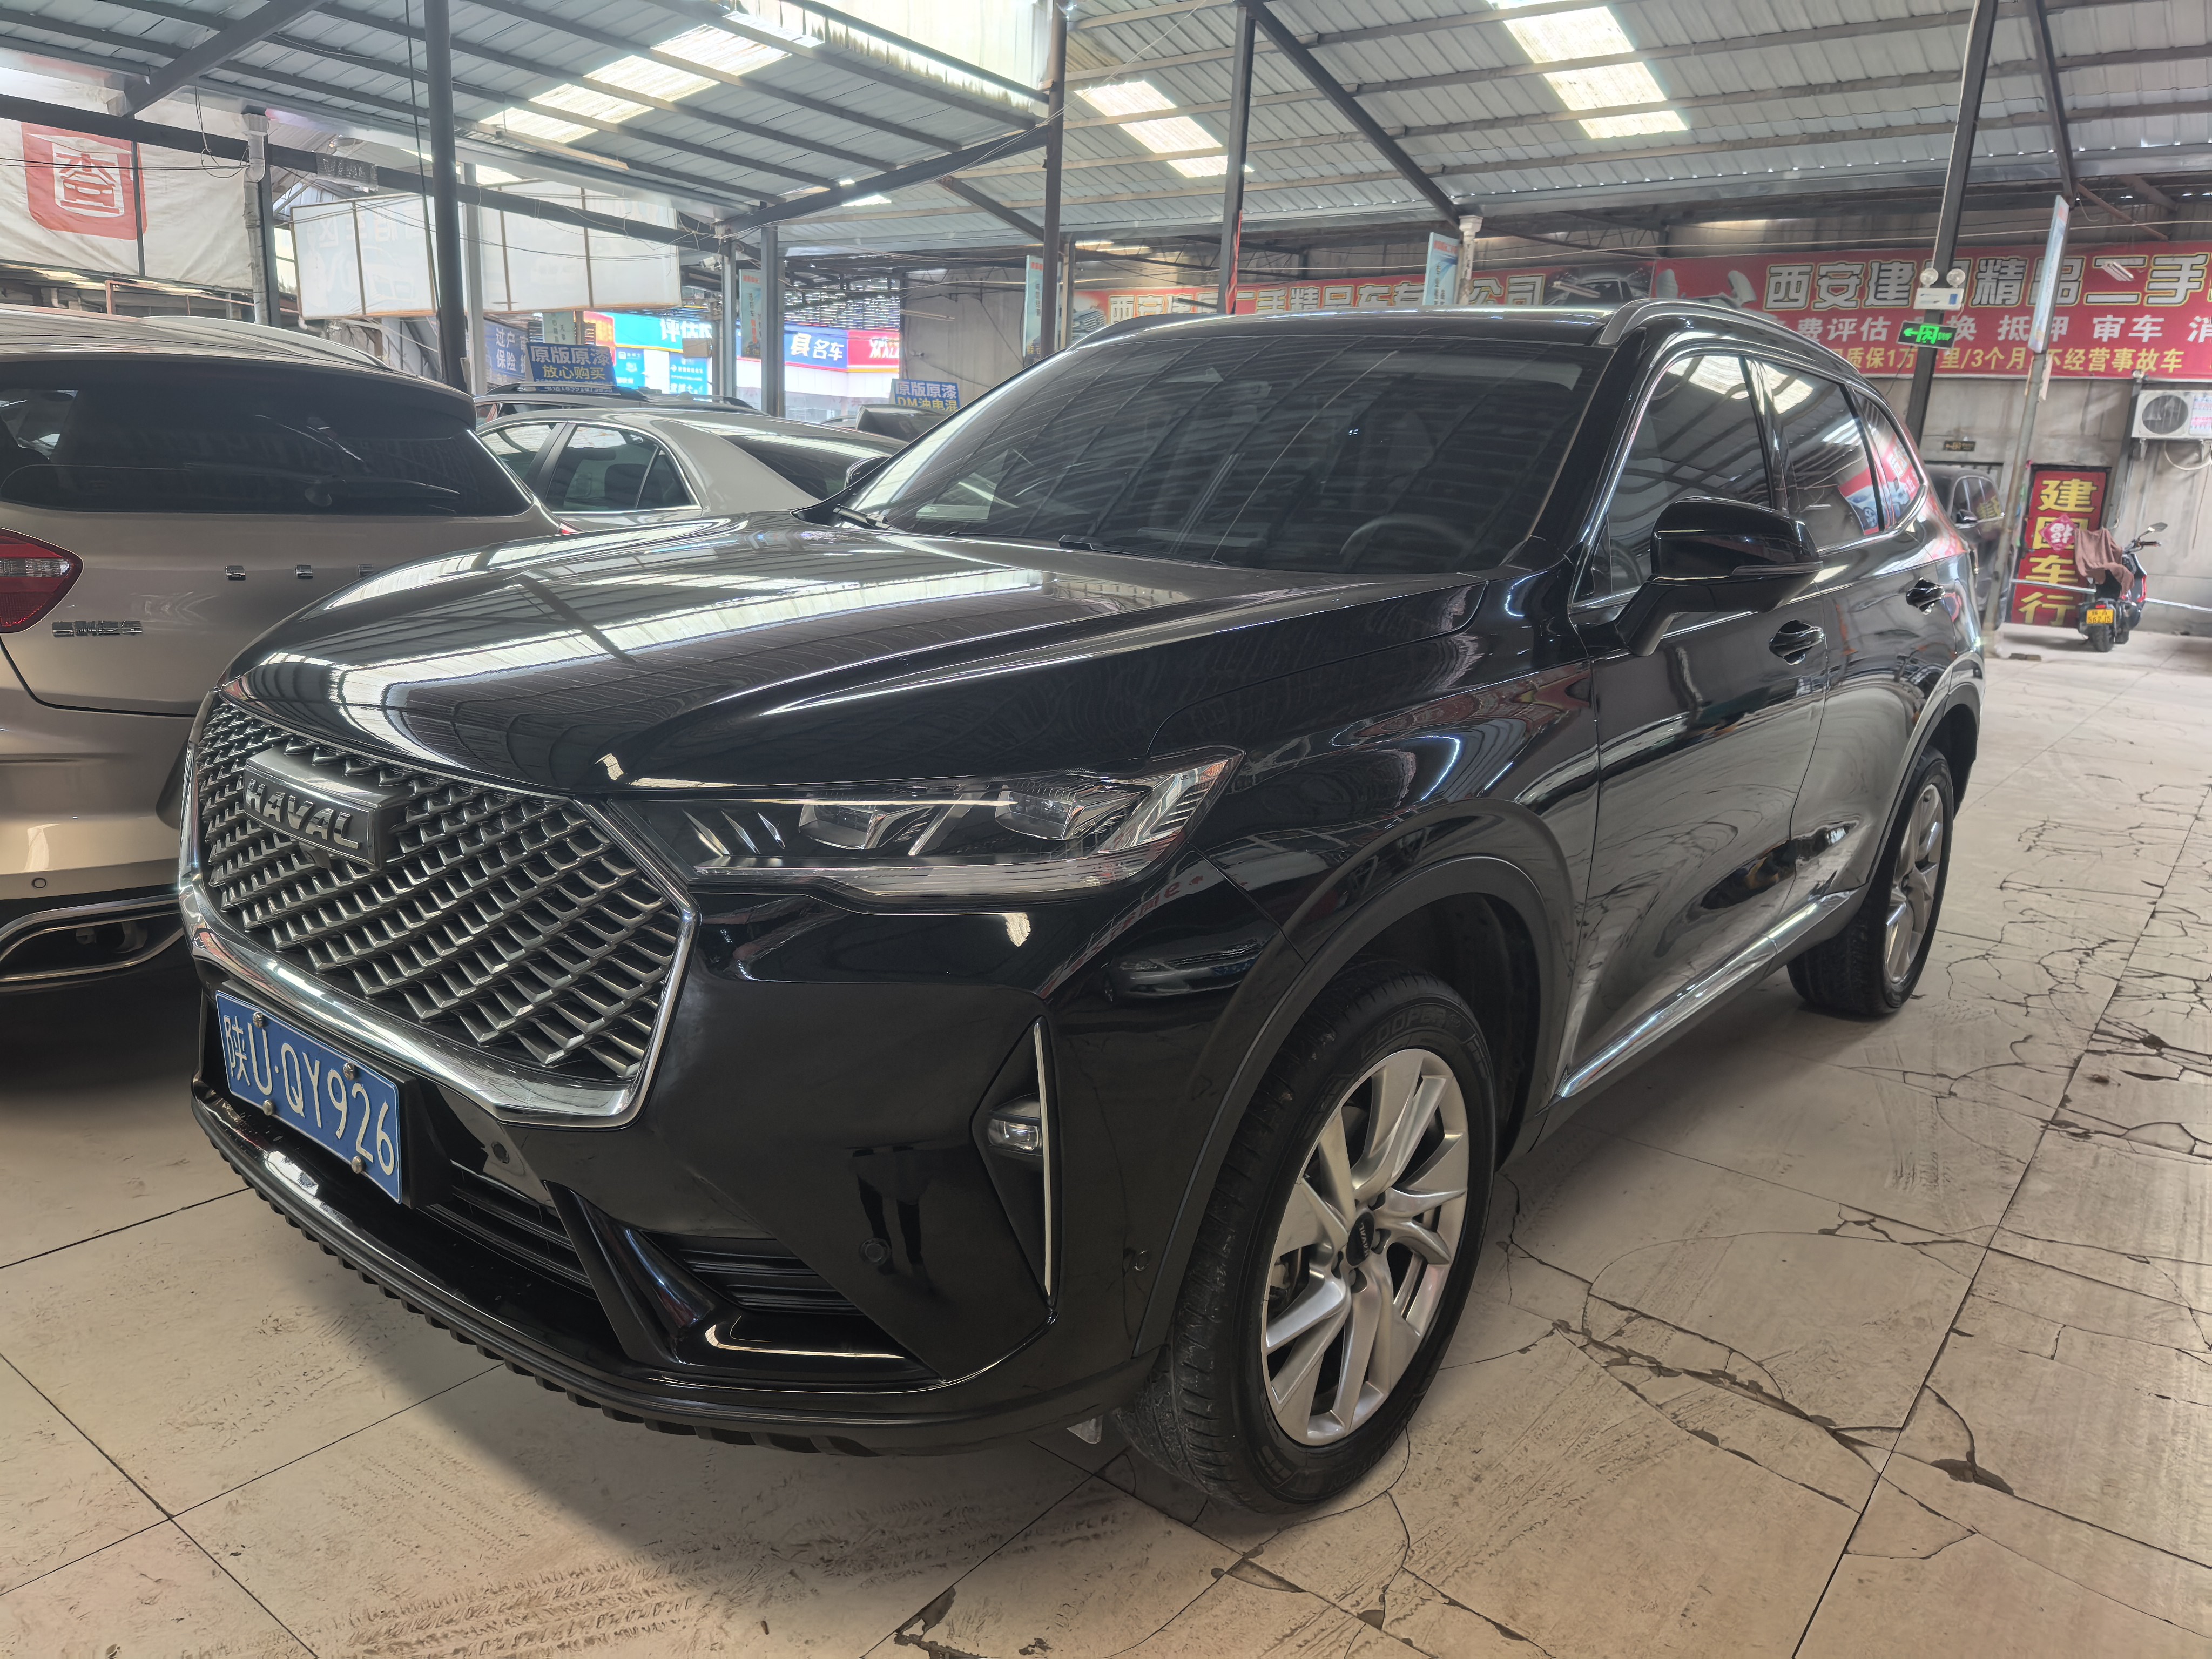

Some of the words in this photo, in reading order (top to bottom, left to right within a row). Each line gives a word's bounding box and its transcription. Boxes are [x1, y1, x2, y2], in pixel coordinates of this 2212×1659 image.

[1778, 315, 1891, 343] 费评估
[2093, 315, 2164, 343] 审车
[496, 348, 516, 373] 保险
[530, 345, 610, 366] 原版原漆
[1833, 347, 2029, 370] 质保1万里/3个月
[542, 365, 606, 380] 放心购买
[896, 381, 957, 399] 原版原漆
[898, 396, 958, 412] DM油电混
[246, 779, 359, 849] HAVAL
